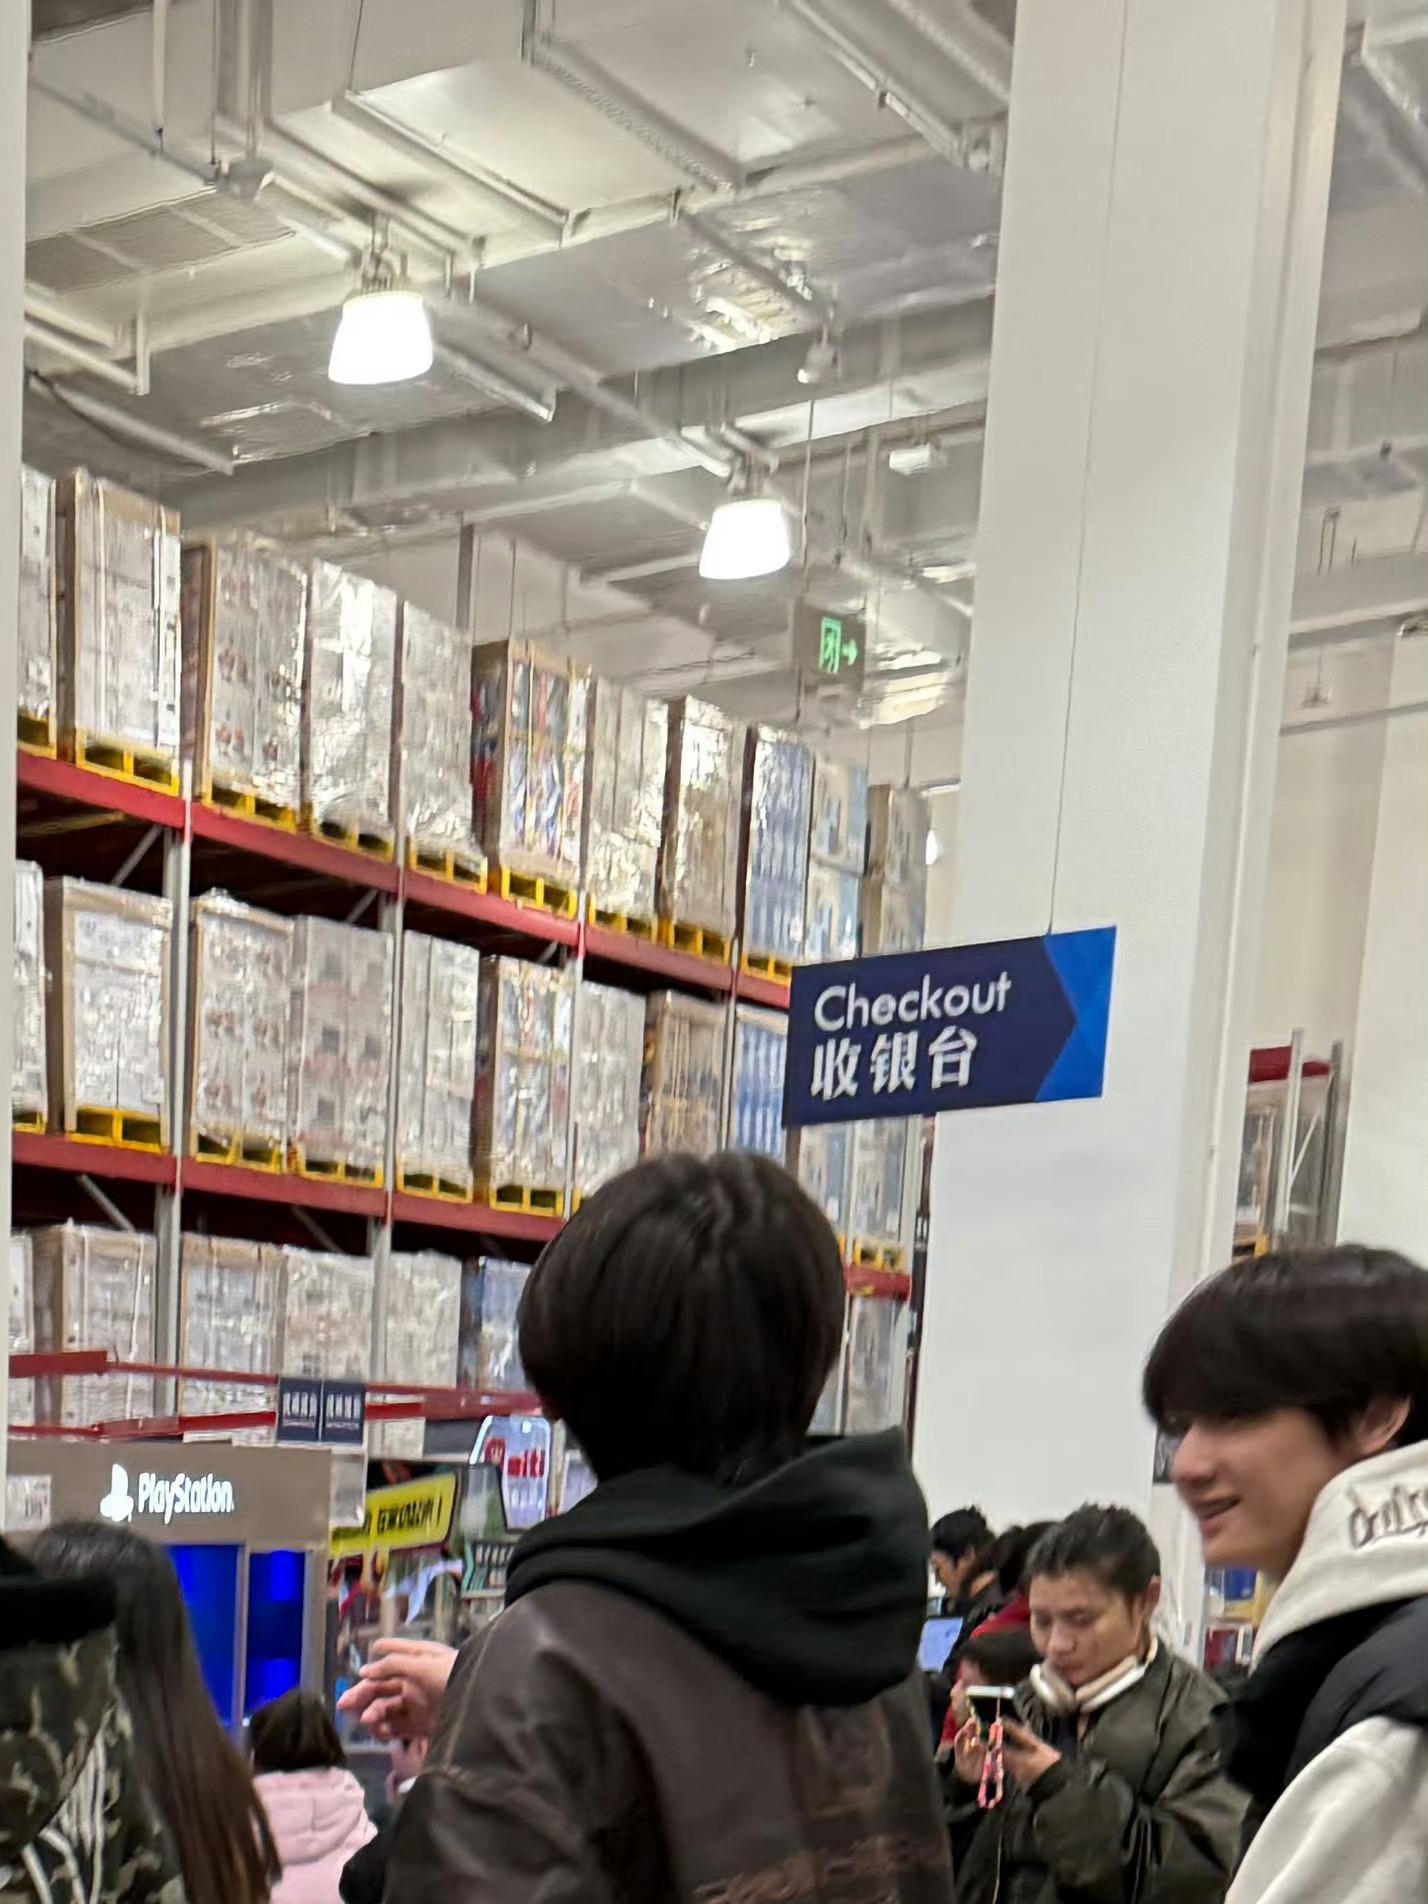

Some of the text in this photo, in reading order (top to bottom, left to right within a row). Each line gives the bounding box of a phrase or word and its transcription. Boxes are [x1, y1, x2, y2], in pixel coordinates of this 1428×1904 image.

[814, 970, 1011, 1032] Checkout
[810, 1025, 977, 1101] 收银台
[138, 1472, 234, 1525] PlayStation
